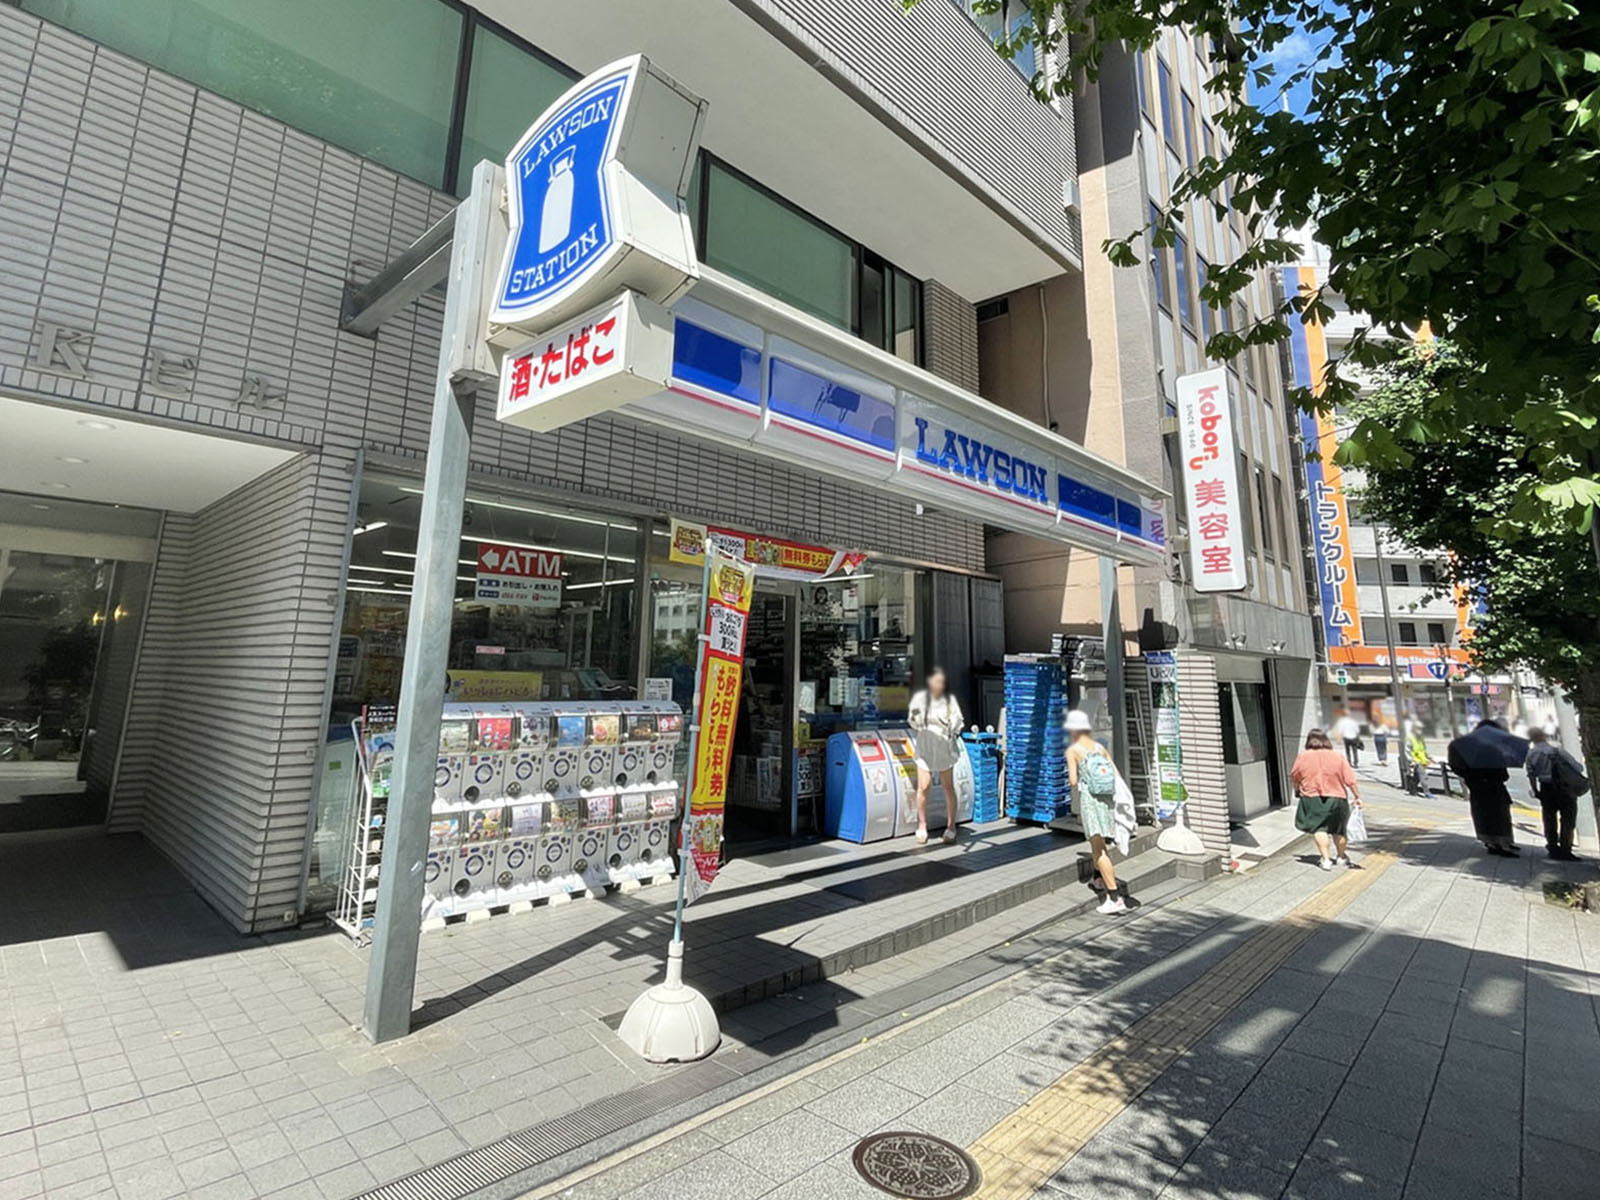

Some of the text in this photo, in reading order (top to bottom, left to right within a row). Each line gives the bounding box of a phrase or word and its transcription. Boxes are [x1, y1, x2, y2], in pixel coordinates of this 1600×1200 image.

[522, 95, 614, 179] LAWSON
[510, 222, 600, 294] STATION
[508, 316, 618, 402] 酒・たばこ
[914, 417, 1049, 504] LAWSON
[500, 549, 561, 577] ATM
[1194, 477, 1233, 575] 美容室
[1315, 480, 1353, 627] トランクルーム
[1431, 664, 1446, 674] 17
